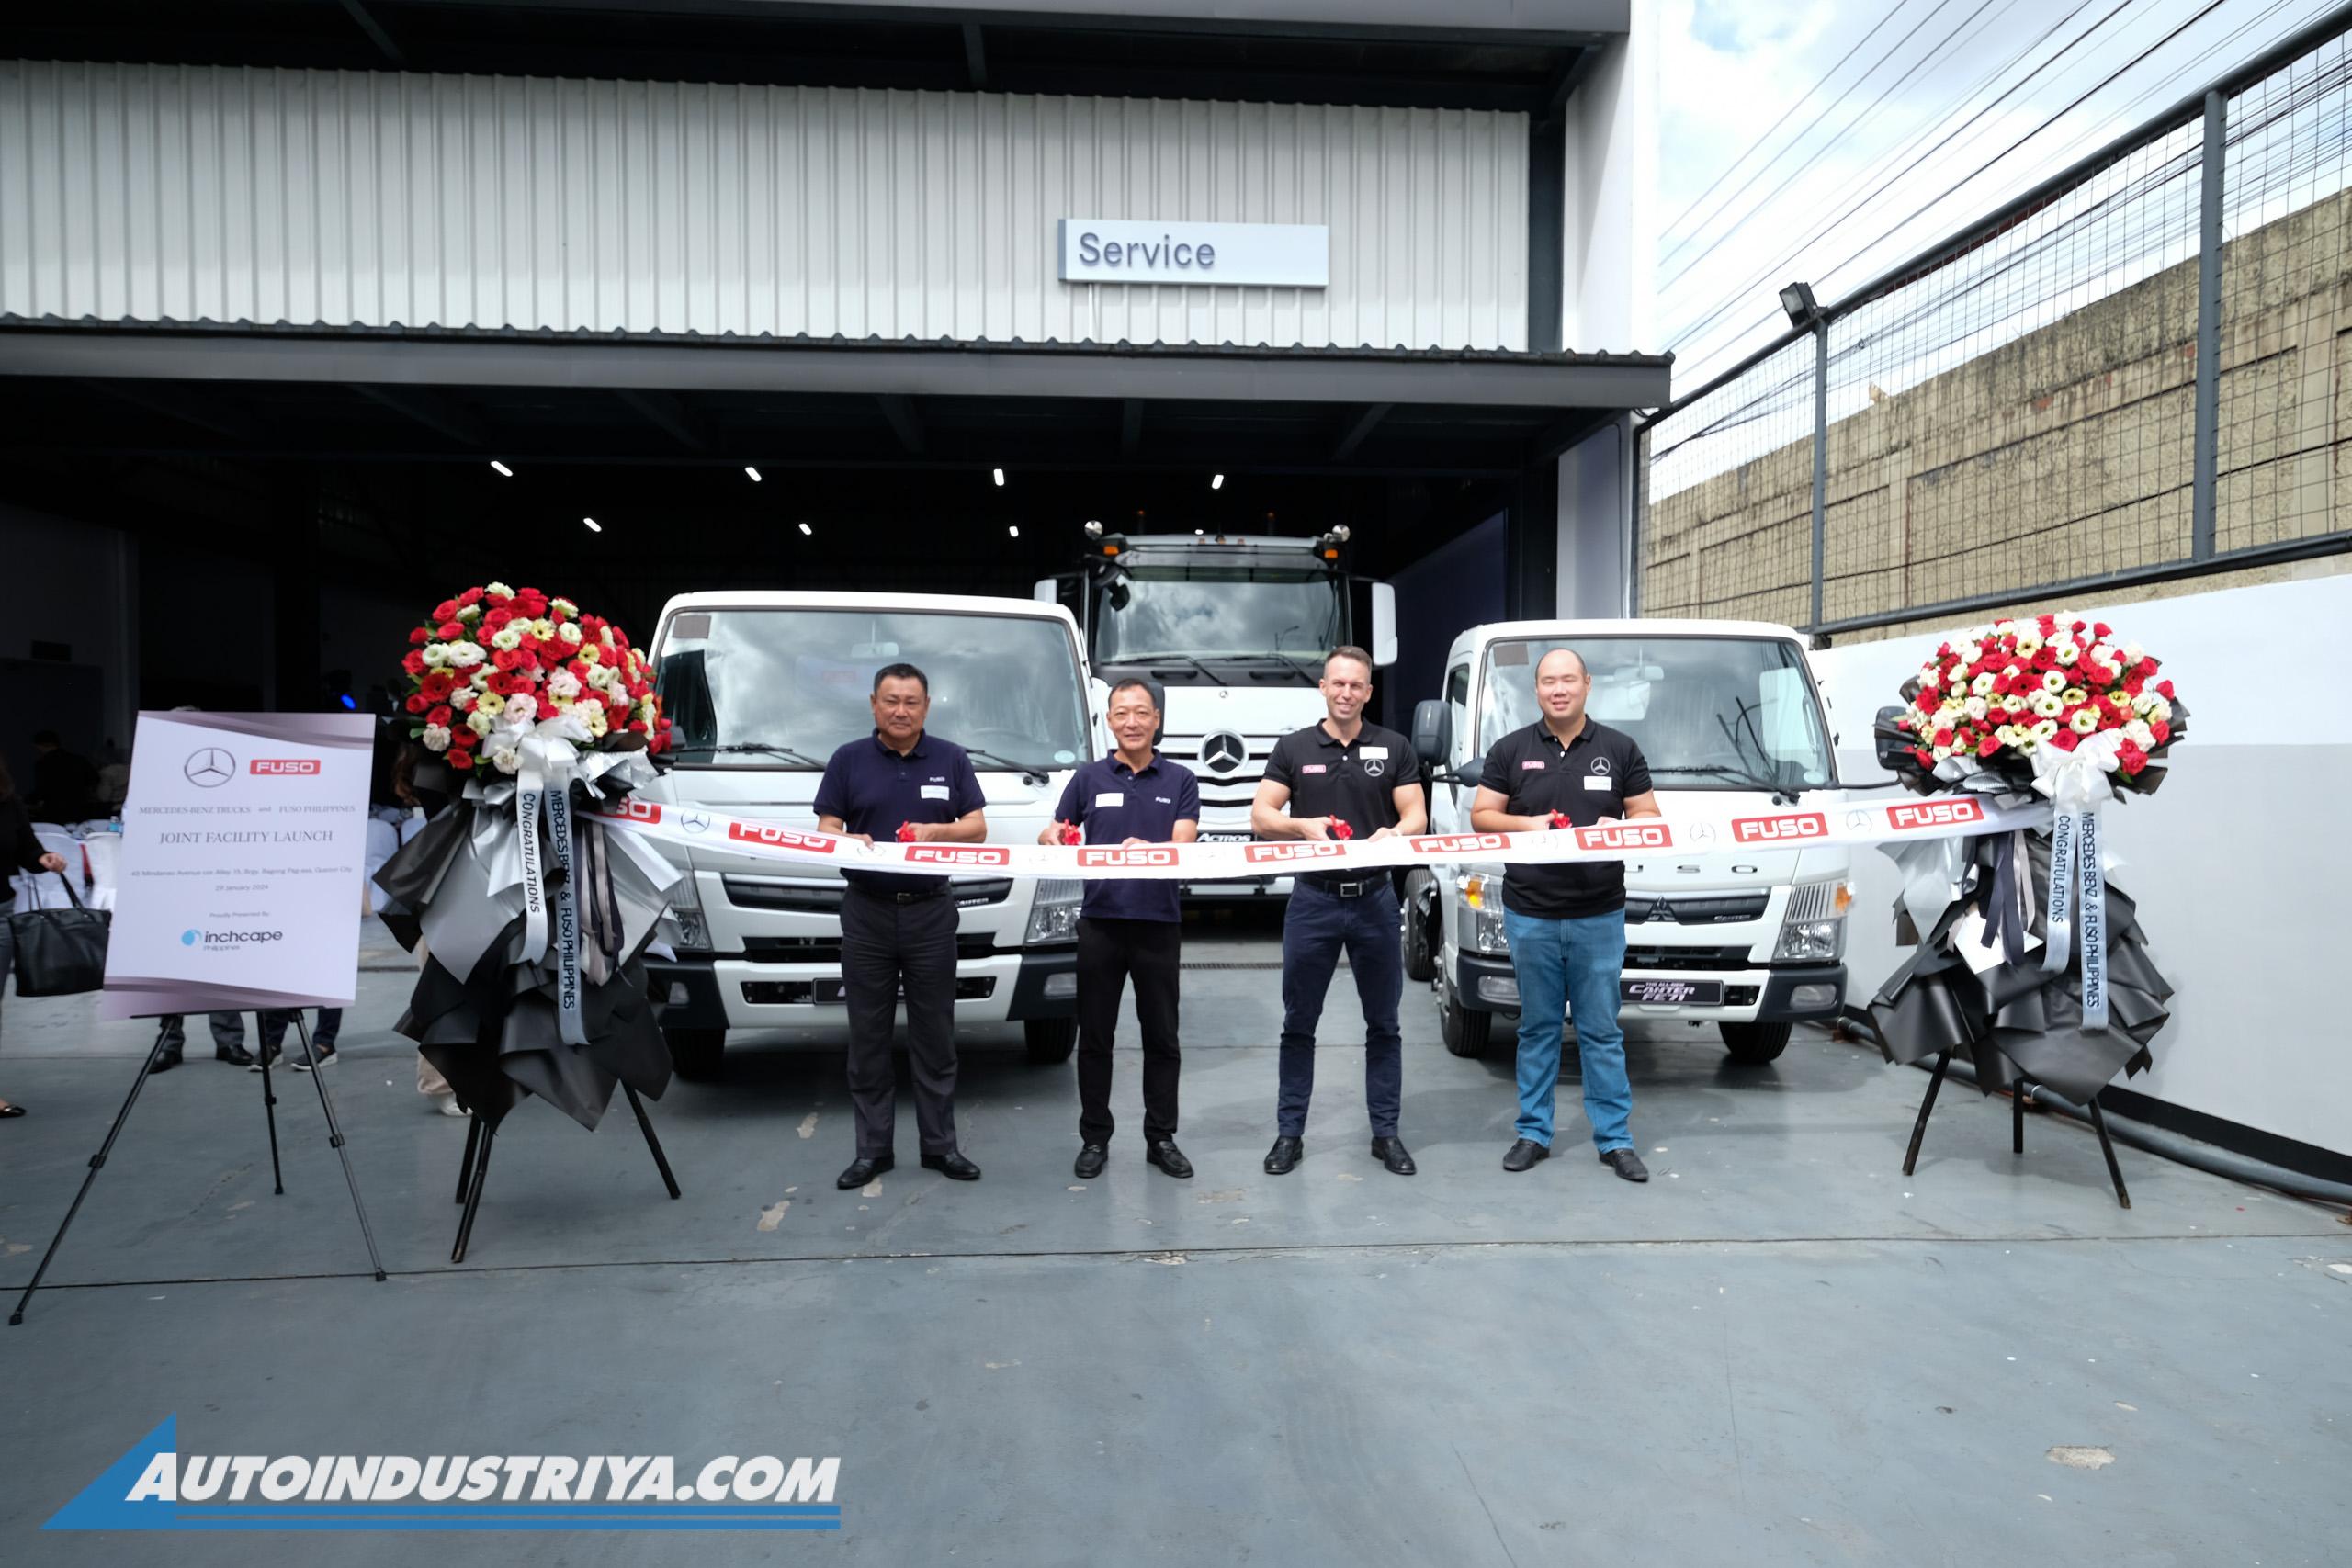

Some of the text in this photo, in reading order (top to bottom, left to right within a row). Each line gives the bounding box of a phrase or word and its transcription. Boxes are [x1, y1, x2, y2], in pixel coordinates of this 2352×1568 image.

[1080, 232, 1216, 269] Service
[256, 761, 315, 773] FUSO
[304, 805, 356, 813] PHILIPPINES
[616, 799, 651, 818] SO
[1895, 802, 1974, 827] FUSO
[550, 790, 569, 852] MERCEDES
[1739, 817, 1820, 840] FUSO
[159, 829, 333, 844] JOINT FACILITY LAUNCH
[1419, 835, 1502, 852] FUSO
[1583, 828, 1664, 848] FUSO
[522, 793, 540, 913] CONGRATULATIONS
[914, 849, 1001, 864] FUSO
[1086, 850, 1170, 865] FUSO
[1253, 843, 1332, 861] FUSO
[1625, 864, 1758, 874] USO
[2052, 815, 2071, 923] CONGRATULATIONS
[560, 891, 571, 901] &
[2082, 811, 2100, 1008] MERCEDES BENZ & FUSO PHILIPPINES
[560, 908, 573, 938] FUSO
[205, 930, 283, 944] inchcape
[562, 940, 575, 1010] PHILIPPINES
[1629, 984, 1696, 995] CANTER
